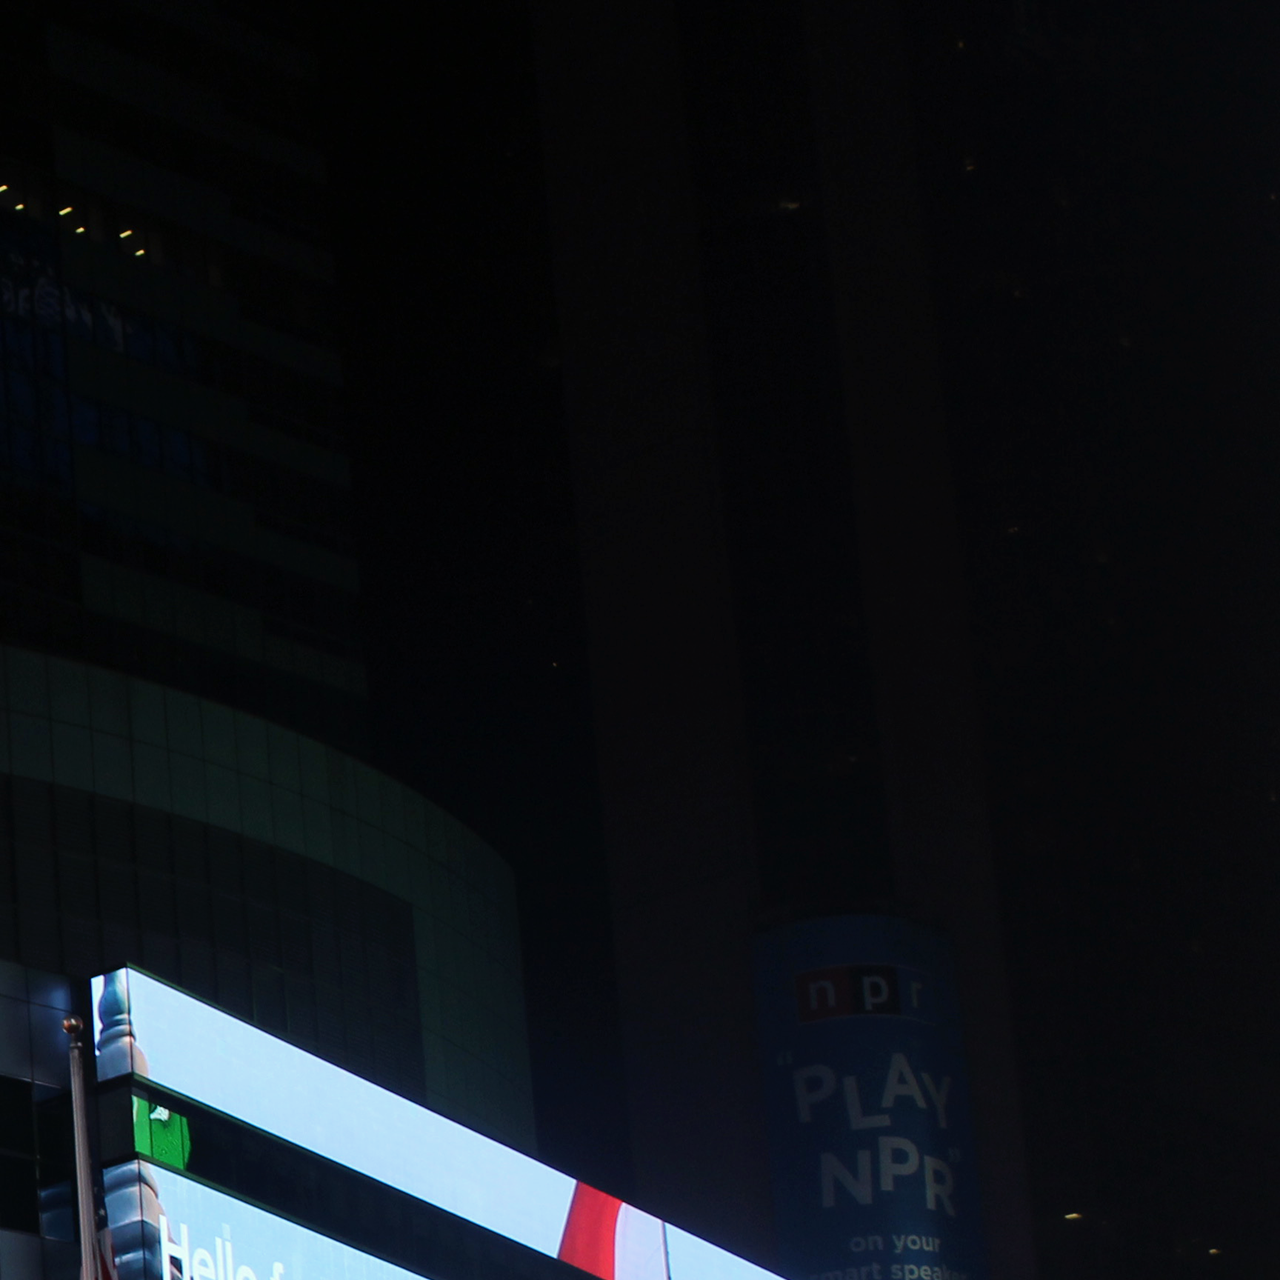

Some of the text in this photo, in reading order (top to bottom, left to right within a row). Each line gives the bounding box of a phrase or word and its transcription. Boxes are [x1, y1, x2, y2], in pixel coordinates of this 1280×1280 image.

[808, 973, 924, 1011] npr
[849, 1233, 941, 1255] on your
